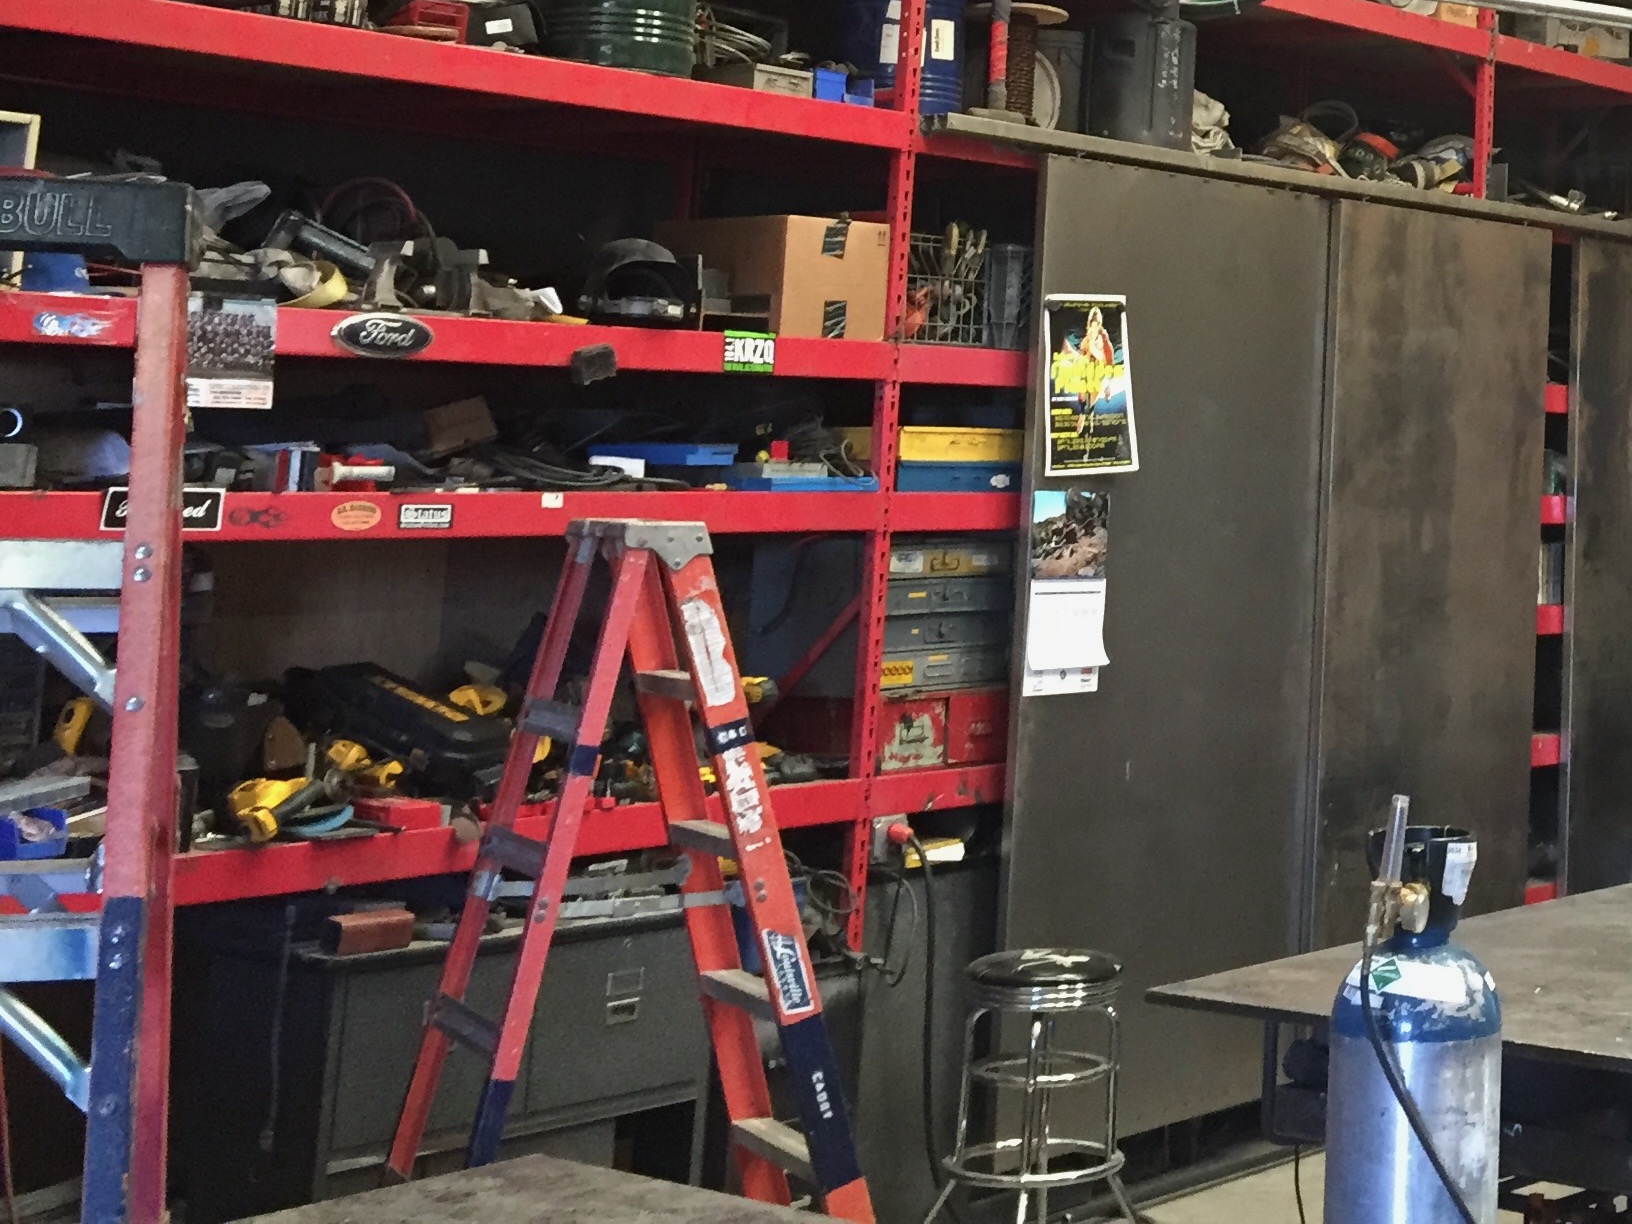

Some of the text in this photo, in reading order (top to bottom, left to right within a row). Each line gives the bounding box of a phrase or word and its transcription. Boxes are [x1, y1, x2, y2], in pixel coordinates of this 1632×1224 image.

[0, 191, 112, 237] BULL
[358, 319, 418, 348] Ford
[734, 337, 775, 364] KRZQ
